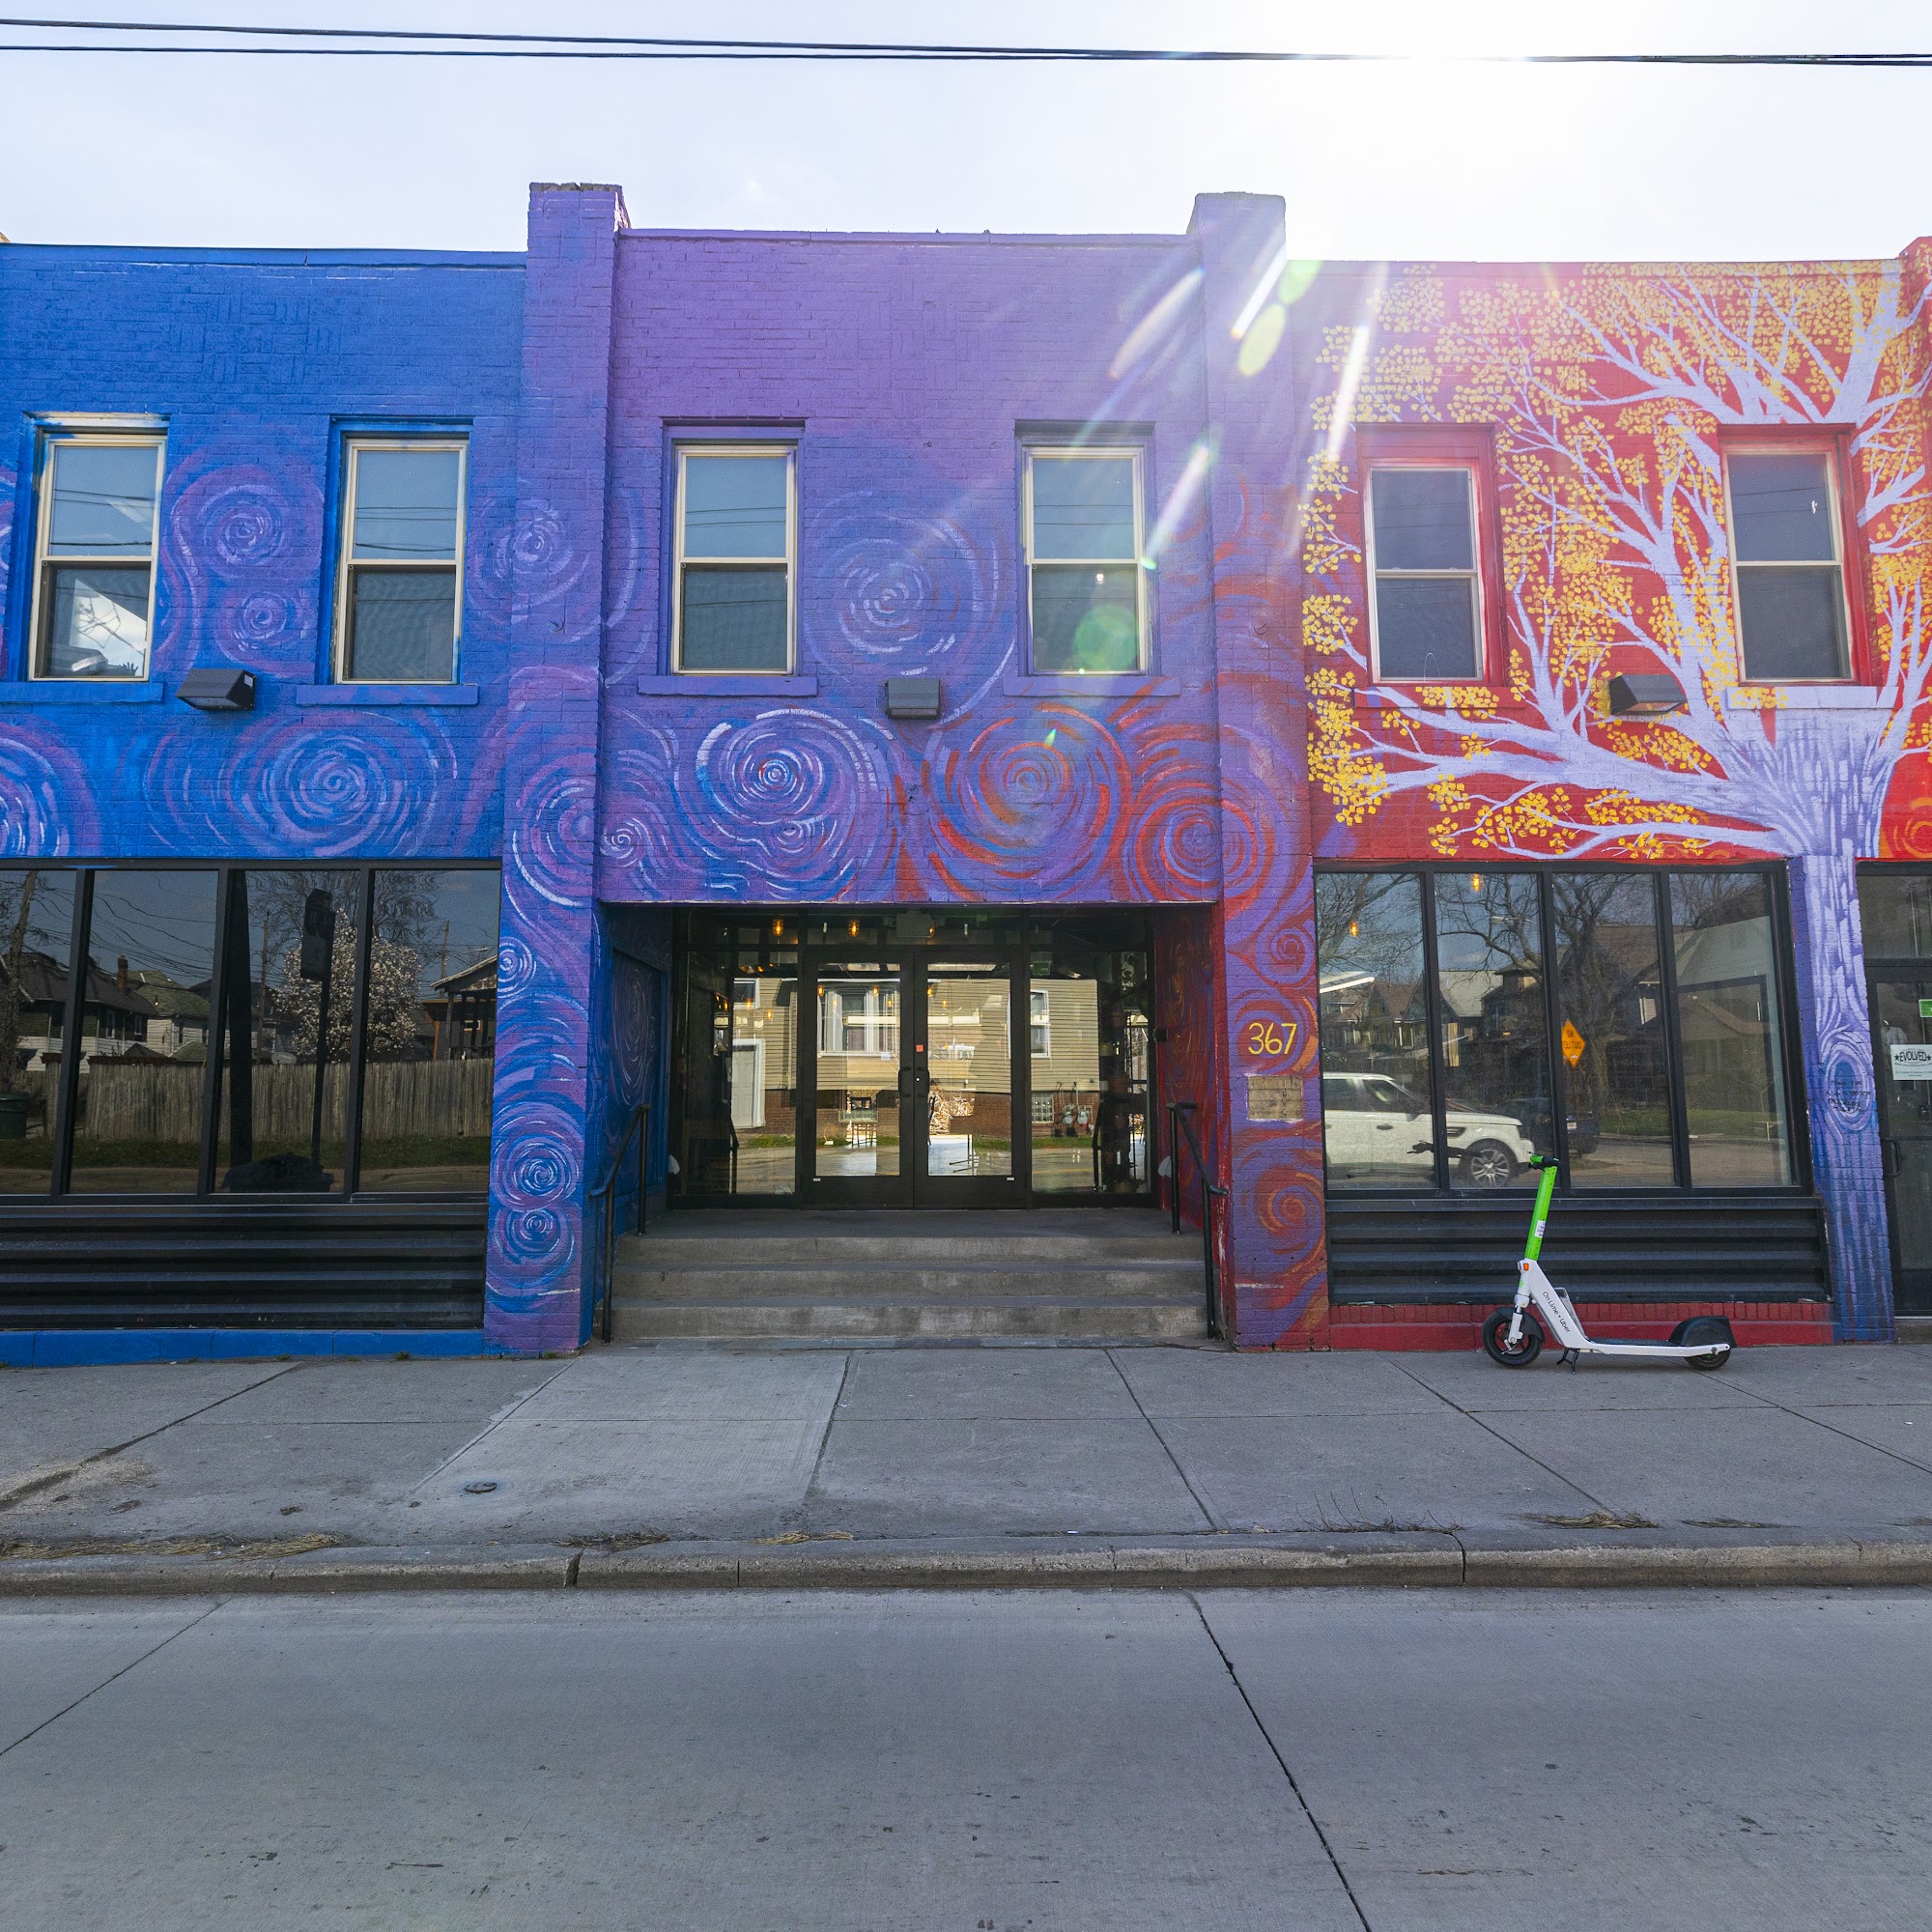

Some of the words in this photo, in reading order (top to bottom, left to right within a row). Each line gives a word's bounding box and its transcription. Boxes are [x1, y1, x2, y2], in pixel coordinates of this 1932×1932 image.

[1248, 1022, 1297, 1055] 367
[1899, 1050, 1927, 1062] EVOLVED
[1542, 1291, 1550, 1302] On
[1548, 1299, 1559, 1315] Lime
[1559, 1318, 1571, 1332] Uber
